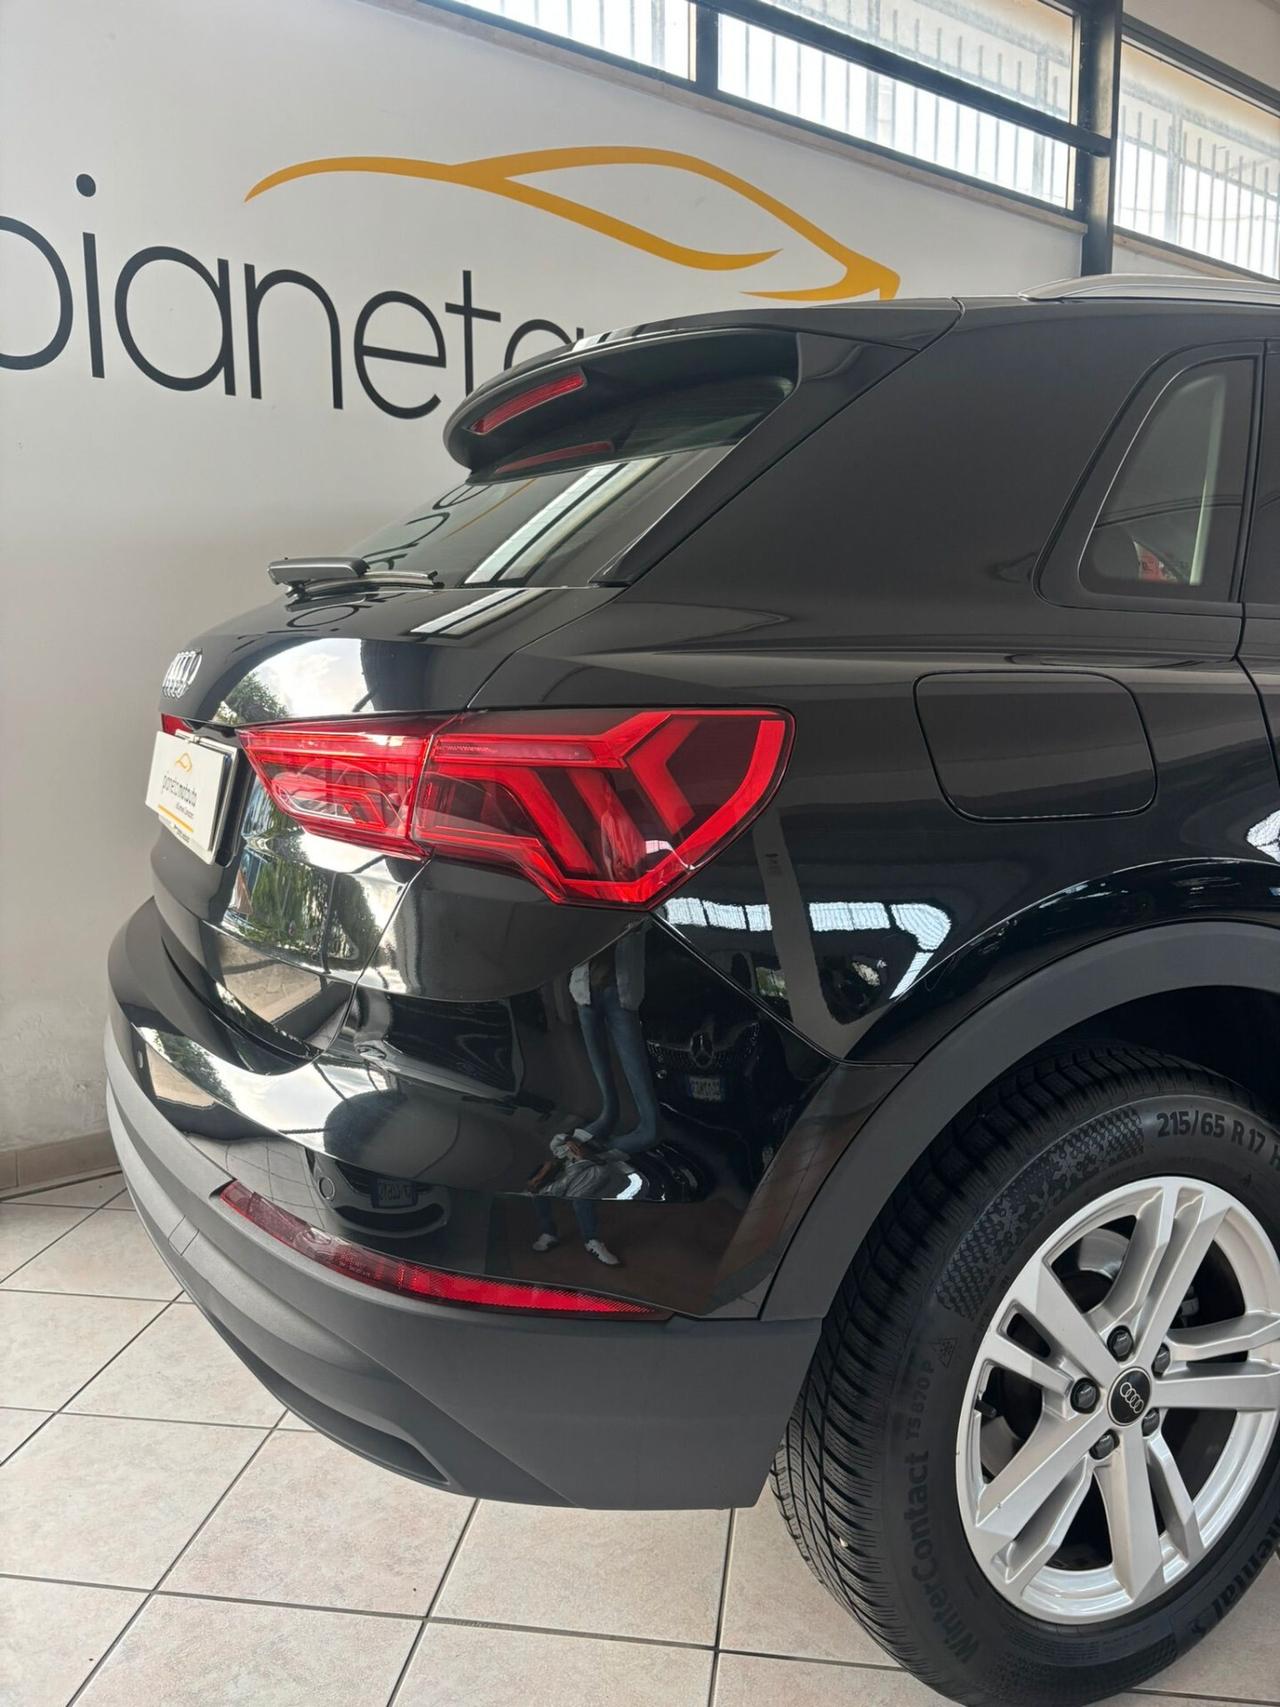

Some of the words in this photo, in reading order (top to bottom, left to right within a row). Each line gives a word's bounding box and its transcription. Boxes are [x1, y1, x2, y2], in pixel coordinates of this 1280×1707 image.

[1156, 1110, 1225, 1138] 215/65
[1231, 1119, 1245, 1146] R
[1248, 1128, 1266, 1154] 17
[904, 1450, 979, 1665] WinterContact
